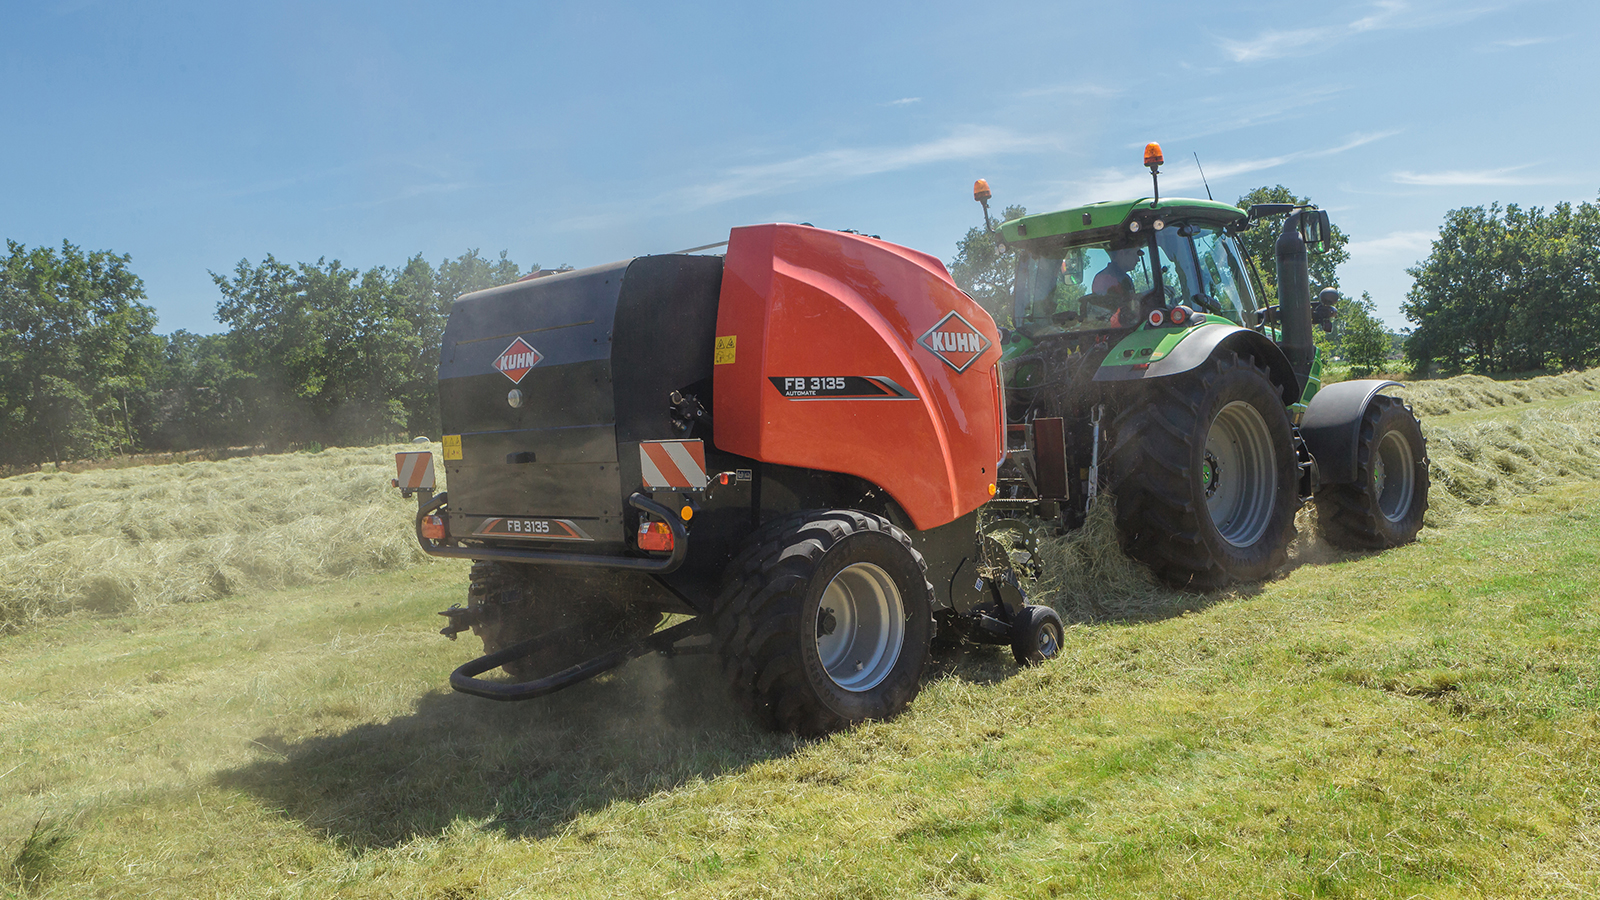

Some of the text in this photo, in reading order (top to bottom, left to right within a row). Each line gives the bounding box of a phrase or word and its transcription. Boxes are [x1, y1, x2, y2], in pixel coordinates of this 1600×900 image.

[931, 332, 981, 352] KUHN
[500, 352, 534, 370] KUHN
[785, 377, 845, 390] FB 3135
[507, 520, 550, 533] FB 3135
